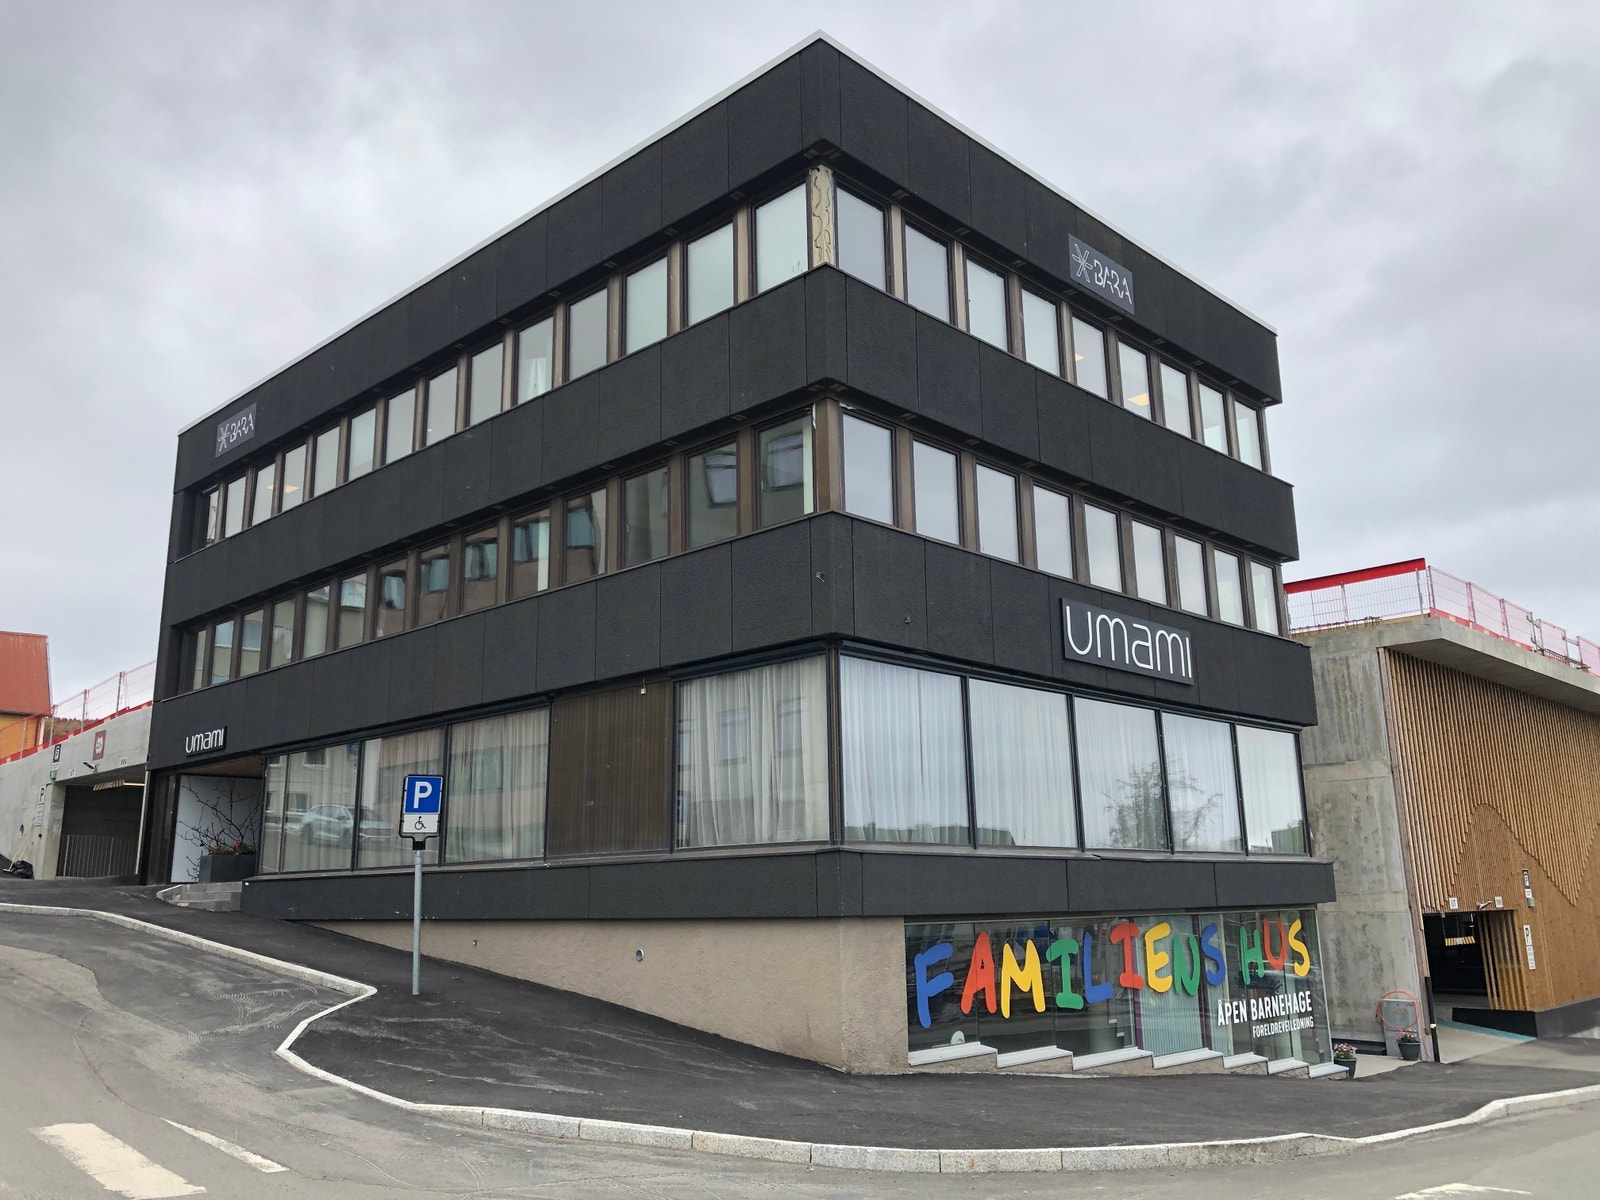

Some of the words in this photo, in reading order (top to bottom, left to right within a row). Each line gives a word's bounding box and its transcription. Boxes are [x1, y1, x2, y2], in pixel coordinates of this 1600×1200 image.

[1093, 258, 1133, 305] BARA
[413, 781, 433, 809] P
[914, 922, 1226, 1029] FAMILIENS
[1240, 917, 1311, 985] HUS
[1217, 999, 1248, 1027] ÅPEN
[1250, 990, 1313, 1021] BARNEHAGE
[1252, 1016, 1314, 1038] FORELDREVEILEDNING
